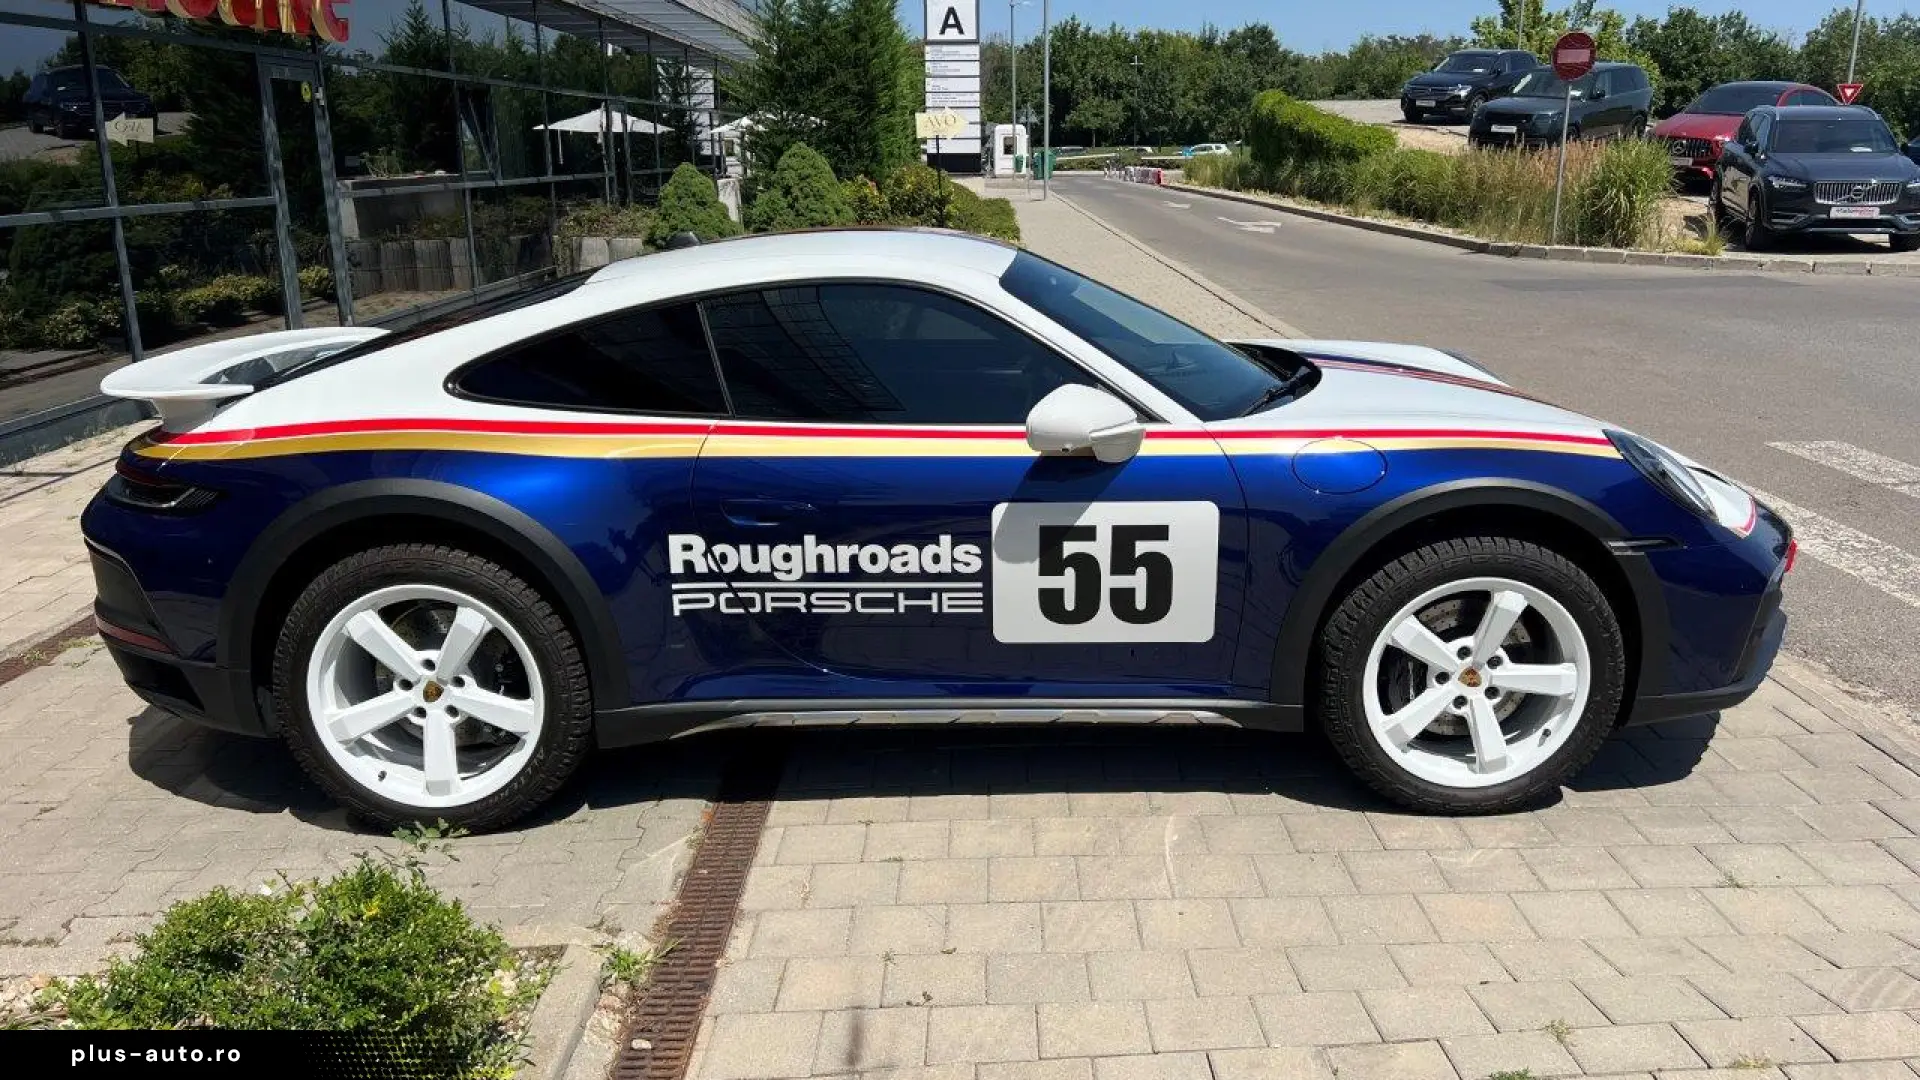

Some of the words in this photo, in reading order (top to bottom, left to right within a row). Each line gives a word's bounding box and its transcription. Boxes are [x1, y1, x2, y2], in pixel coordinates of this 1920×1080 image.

[939, 6, 965, 35] A
[669, 534, 983, 581] Roughroads
[1038, 525, 1174, 625] 55
[671, 592, 984, 616] PORSCHE
